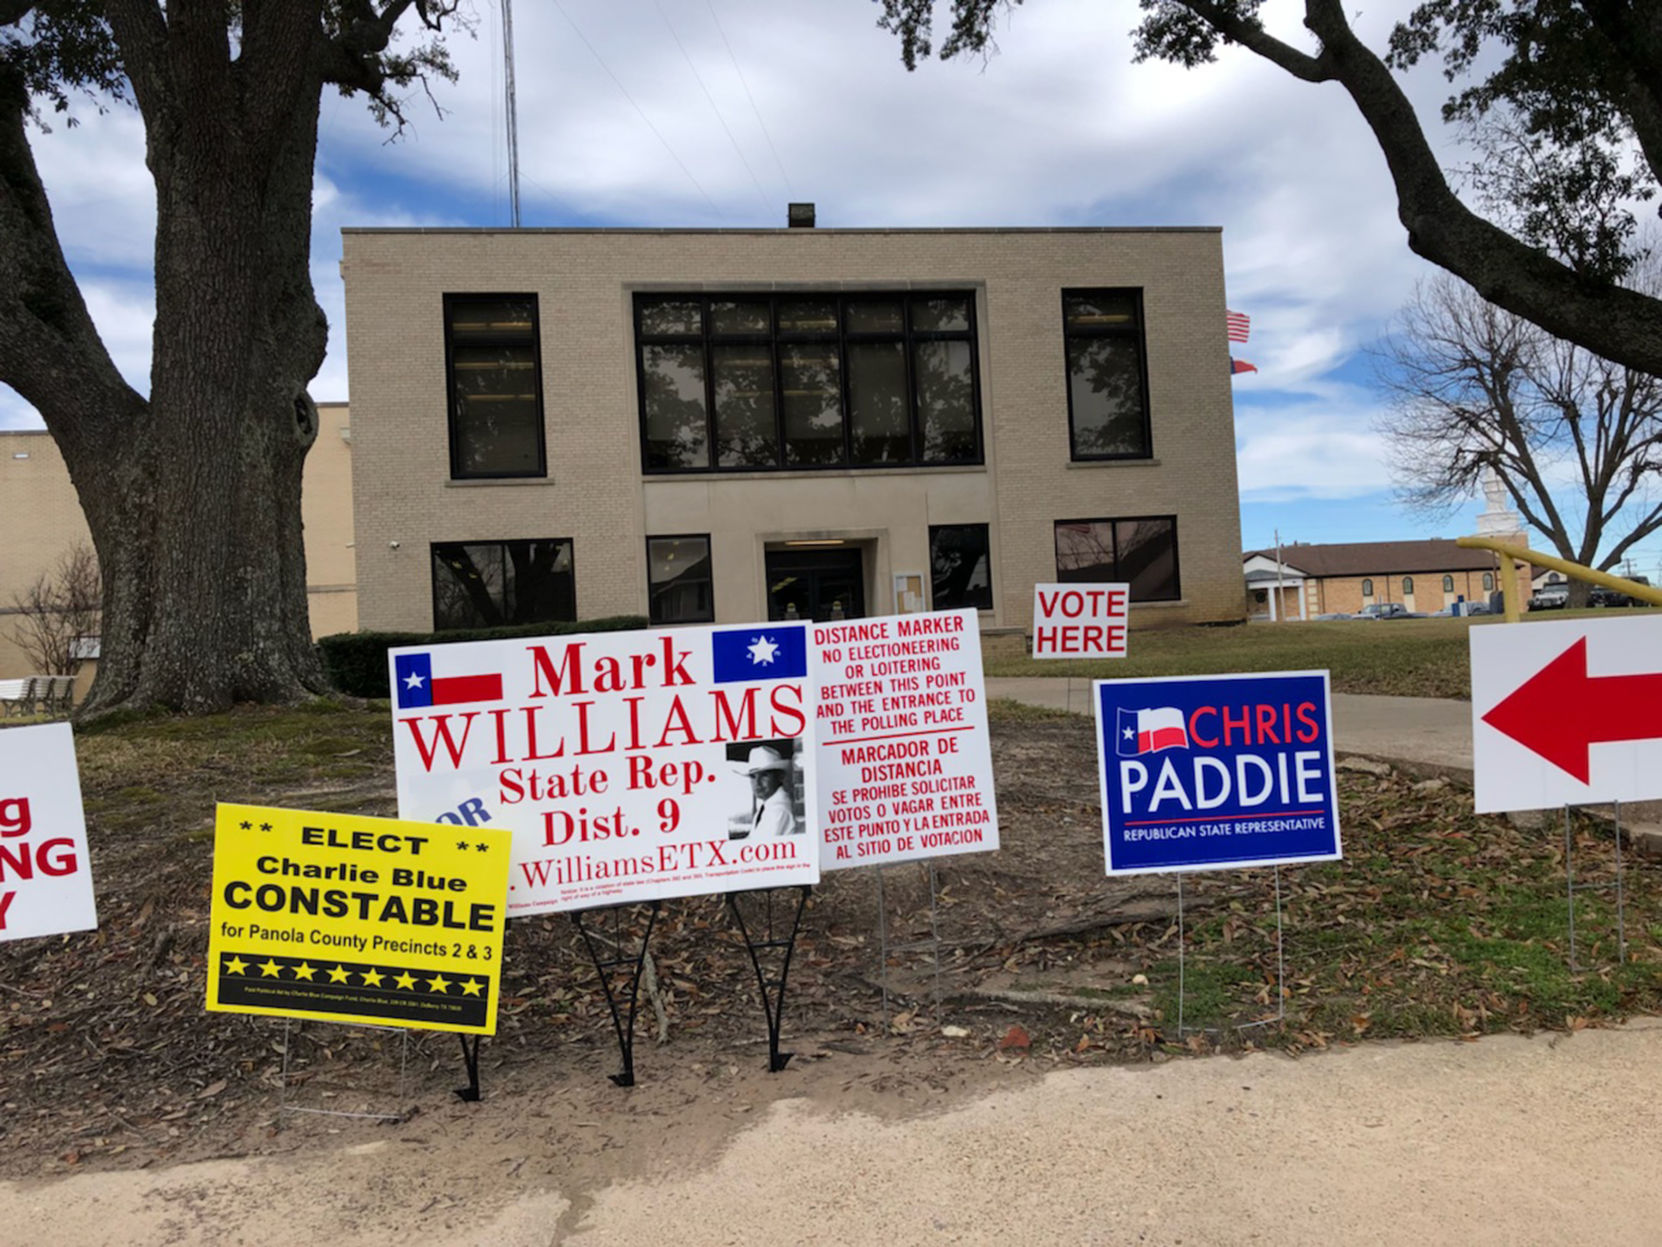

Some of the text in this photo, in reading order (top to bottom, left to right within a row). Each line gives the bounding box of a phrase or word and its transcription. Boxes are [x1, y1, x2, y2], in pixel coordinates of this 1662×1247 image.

[1038, 591, 1126, 618] VOTE
[814, 615, 964, 646] DISTANCE MARKER
[1037, 625, 1125, 653] HERE
[822, 637, 960, 664] NO ELECTIONEERING
[526, 637, 696, 698] Mark
[845, 657, 941, 680] OR LOITERING
[821, 672, 967, 701] BETWEEN THIS POINT
[816, 688, 976, 719] AND THE ENTRANCE TO
[398, 684, 806, 773] WILLIAMS
[830, 707, 965, 735] THE POLLING PLACE
[1189, 702, 1320, 749] CHRIS
[841, 737, 959, 765] MARCADOR DE
[499, 755, 716, 804] State Rep.
[861, 759, 943, 783] DISTANCIA
[1119, 750, 1325, 814] PADDIE
[832, 775, 976, 806] SE PROHIBE SOLICITAR
[541, 798, 680, 846] Dist. 9
[828, 792, 983, 824] VOTOS O VAGAR ENTRE
[301, 827, 429, 855] ELECT
[824, 809, 990, 843] ESTE PUNTO Y LA ENTRADA
[1123, 817, 1326, 842] REPUBLICAN STATE REPRESENTATIVE
[836, 828, 983, 860] AL SITIO DE VOTACION
[257, 856, 467, 892] Charlie Blue
[224, 881, 495, 932] CONSTABLE
[221, 922, 493, 960] for Panola County Precincts 2 & 3
